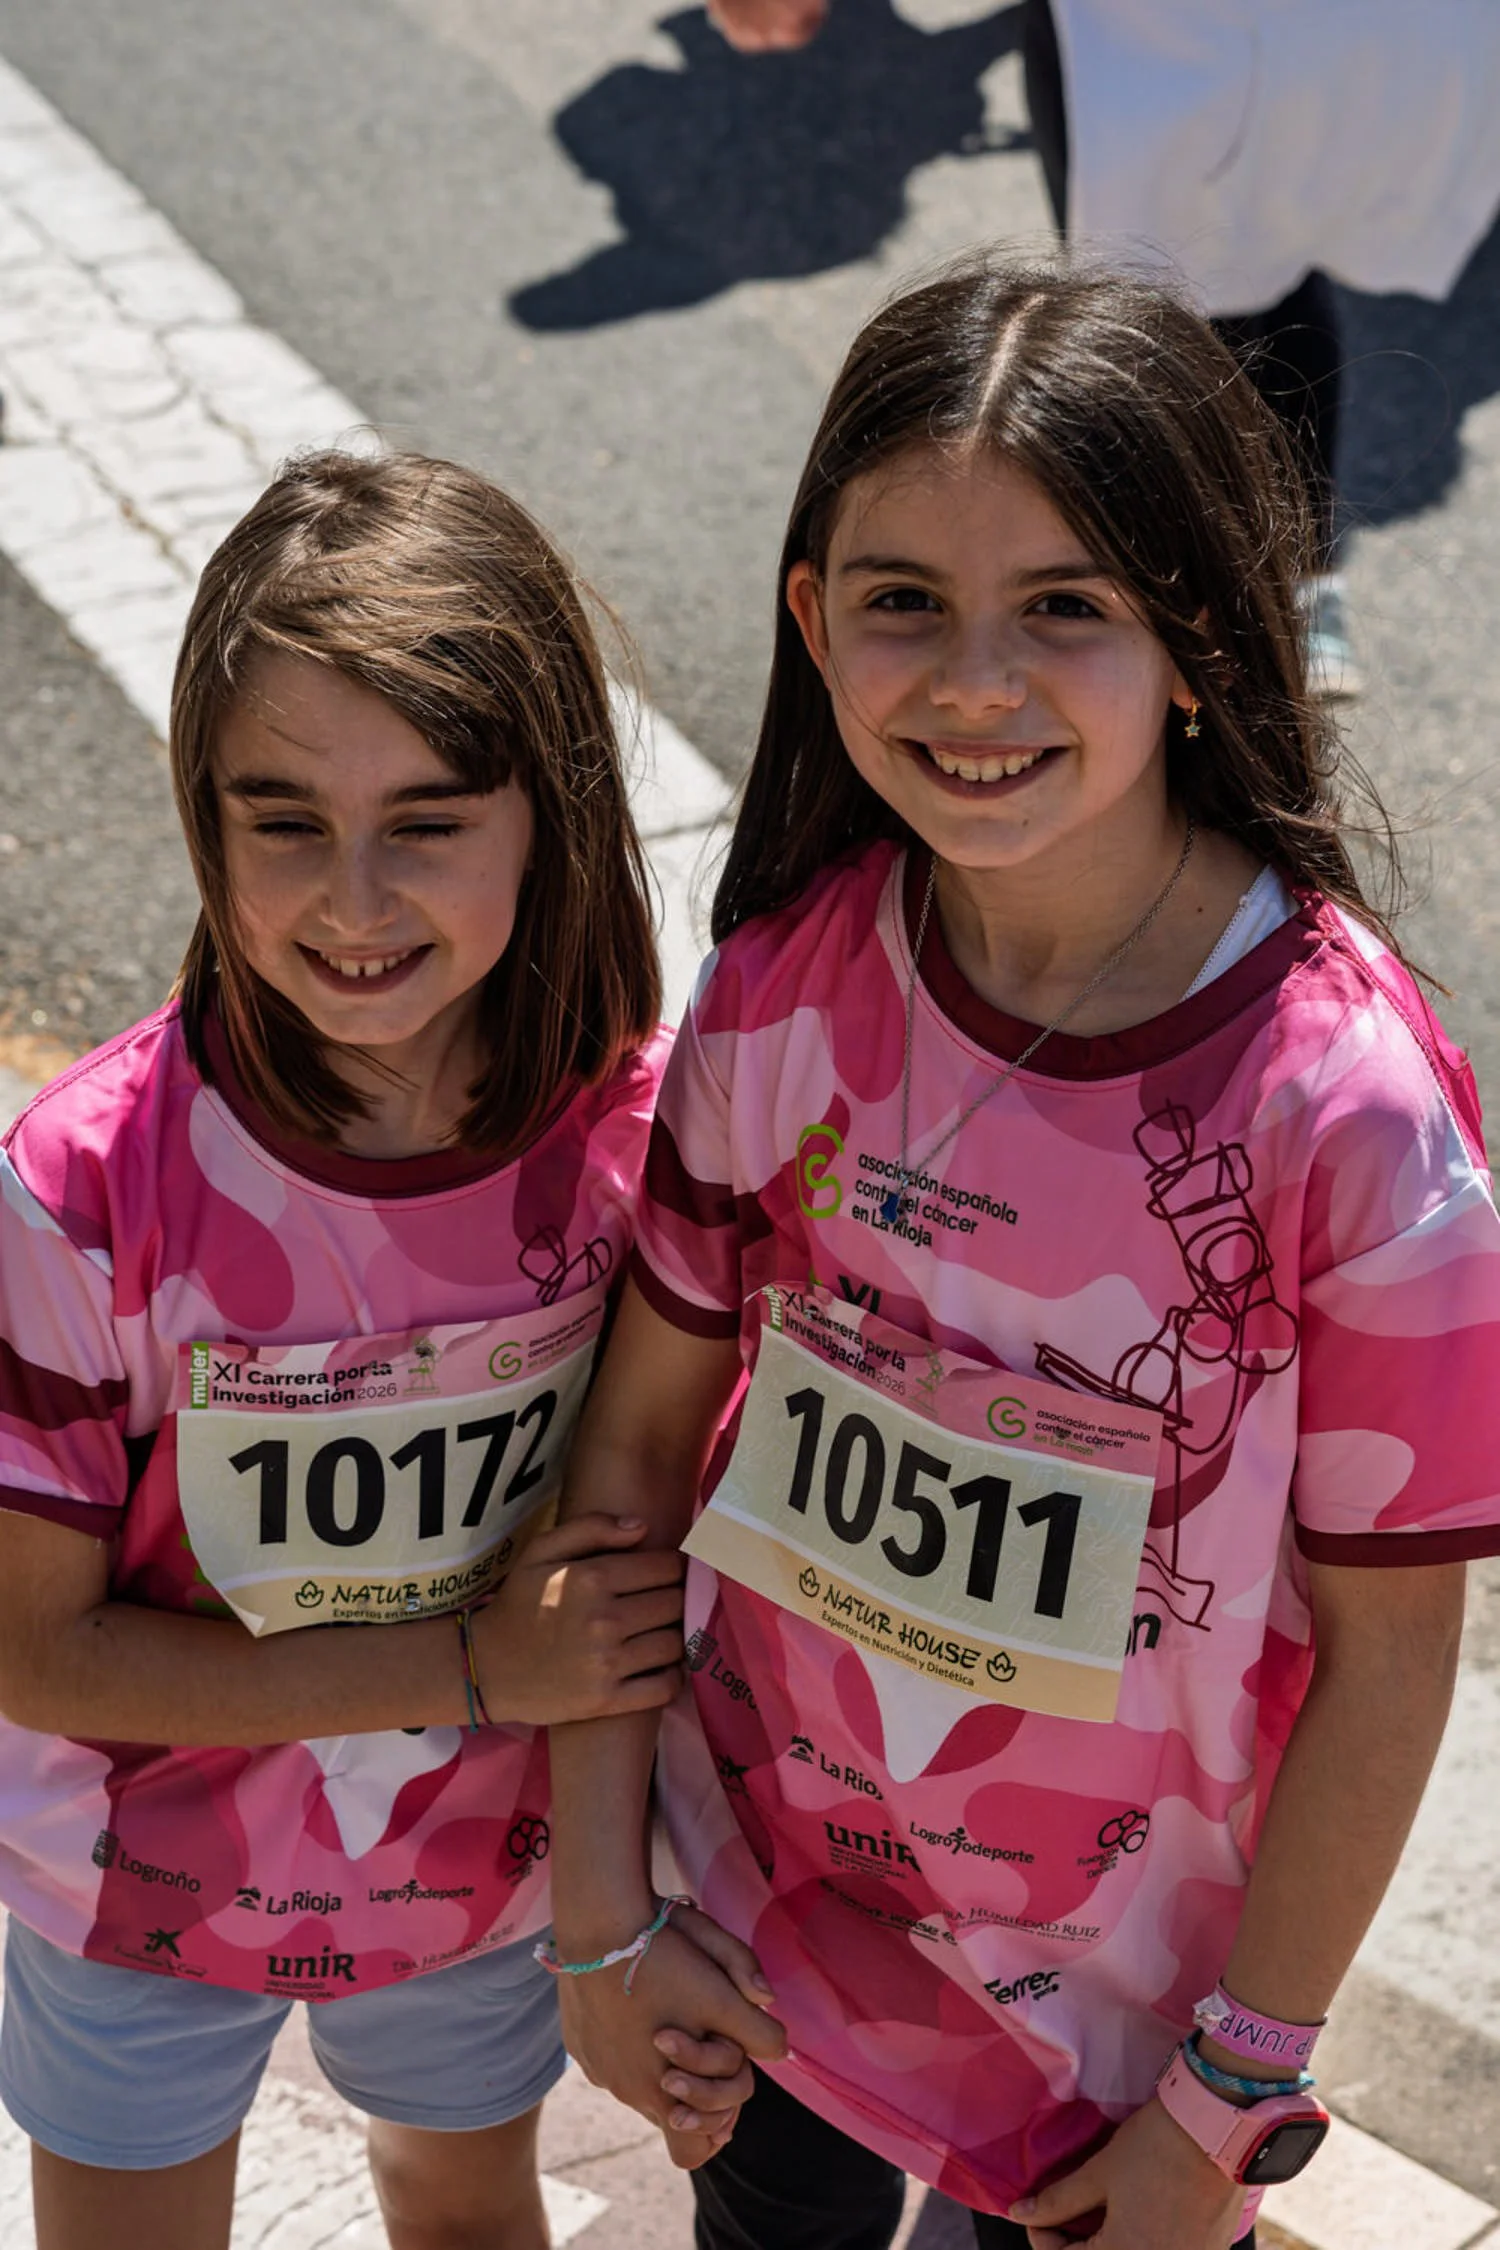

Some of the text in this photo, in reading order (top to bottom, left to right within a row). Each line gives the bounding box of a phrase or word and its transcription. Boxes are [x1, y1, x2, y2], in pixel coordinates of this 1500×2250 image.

[922, 1203, 978, 1235] cáncer
[941, 1184, 1018, 1225] española
[852, 1204, 933, 1247] en La Rioja
[213, 1359, 241, 1383] XI
[247, 1370, 328, 1386] Carrera
[334, 1364, 371, 1386] por
[785, 1311, 906, 1396] investigación 2026
[865, 1339, 890, 1363] por
[892, 1350, 906, 1372] la
[189, 1347, 210, 1404] mujer
[212, 1382, 397, 1409] investigación 2026
[1037, 1409, 1151, 1443] asociación española
[1073, 1431, 1084, 1442] el
[229, 1389, 558, 1547] 10172
[785, 1387, 1082, 1620] 10511
[330, 1582, 421, 1604] NATUR
[428, 1553, 496, 1598] HOUSE
[823, 1583, 982, 1669] NATUR HOUSE
[821, 1610, 975, 1687] Expertos en Nutrición y Dietética
[819, 1752, 841, 1780] La
[119, 1850, 201, 1893] Logroño
[265, 1890, 342, 1916] La Rioja
[1062, 1924, 1102, 1939] RUIZ
[984, 1971, 1061, 2005] Ferrer
[1219, 2014, 1294, 2053] JUMP
